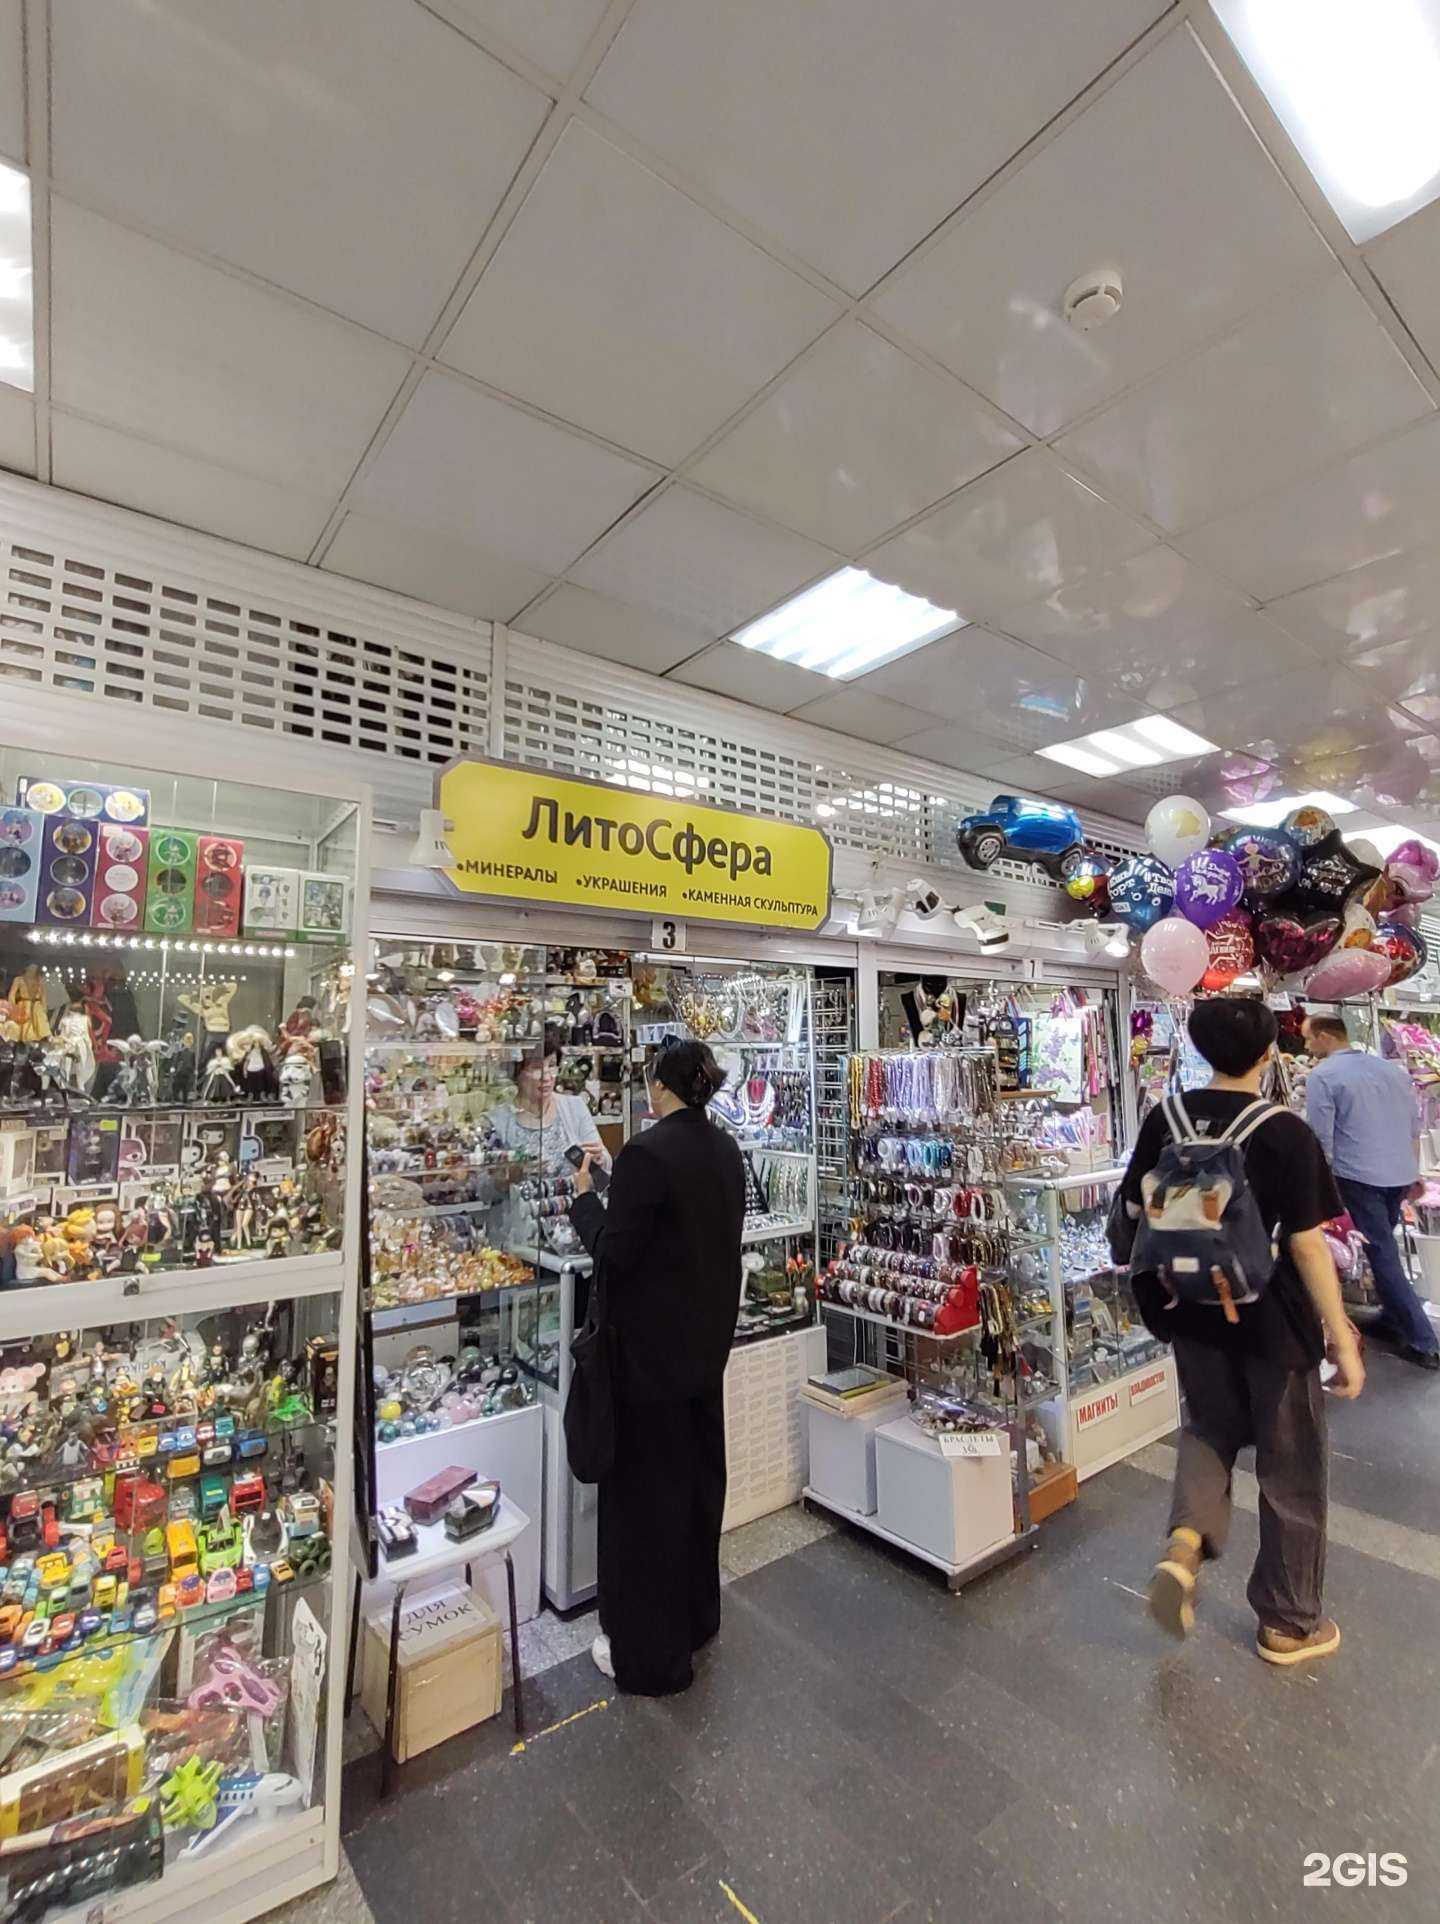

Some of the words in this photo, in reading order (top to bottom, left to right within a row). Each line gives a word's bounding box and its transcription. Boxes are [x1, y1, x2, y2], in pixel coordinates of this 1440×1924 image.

[521, 795, 772, 881] ЛитоСфера
[465, 859, 559, 885] МИНЕРАЛЫ
[582, 874, 668, 899] УКРАШЕНИЯ
[687, 888, 751, 909] КАМЕННАЯ
[753, 897, 819, 917] СКУЛЬПТУРА
[662, 920, 676, 950] 3
[1079, 1391, 1119, 1425] МАГНИТЫ
